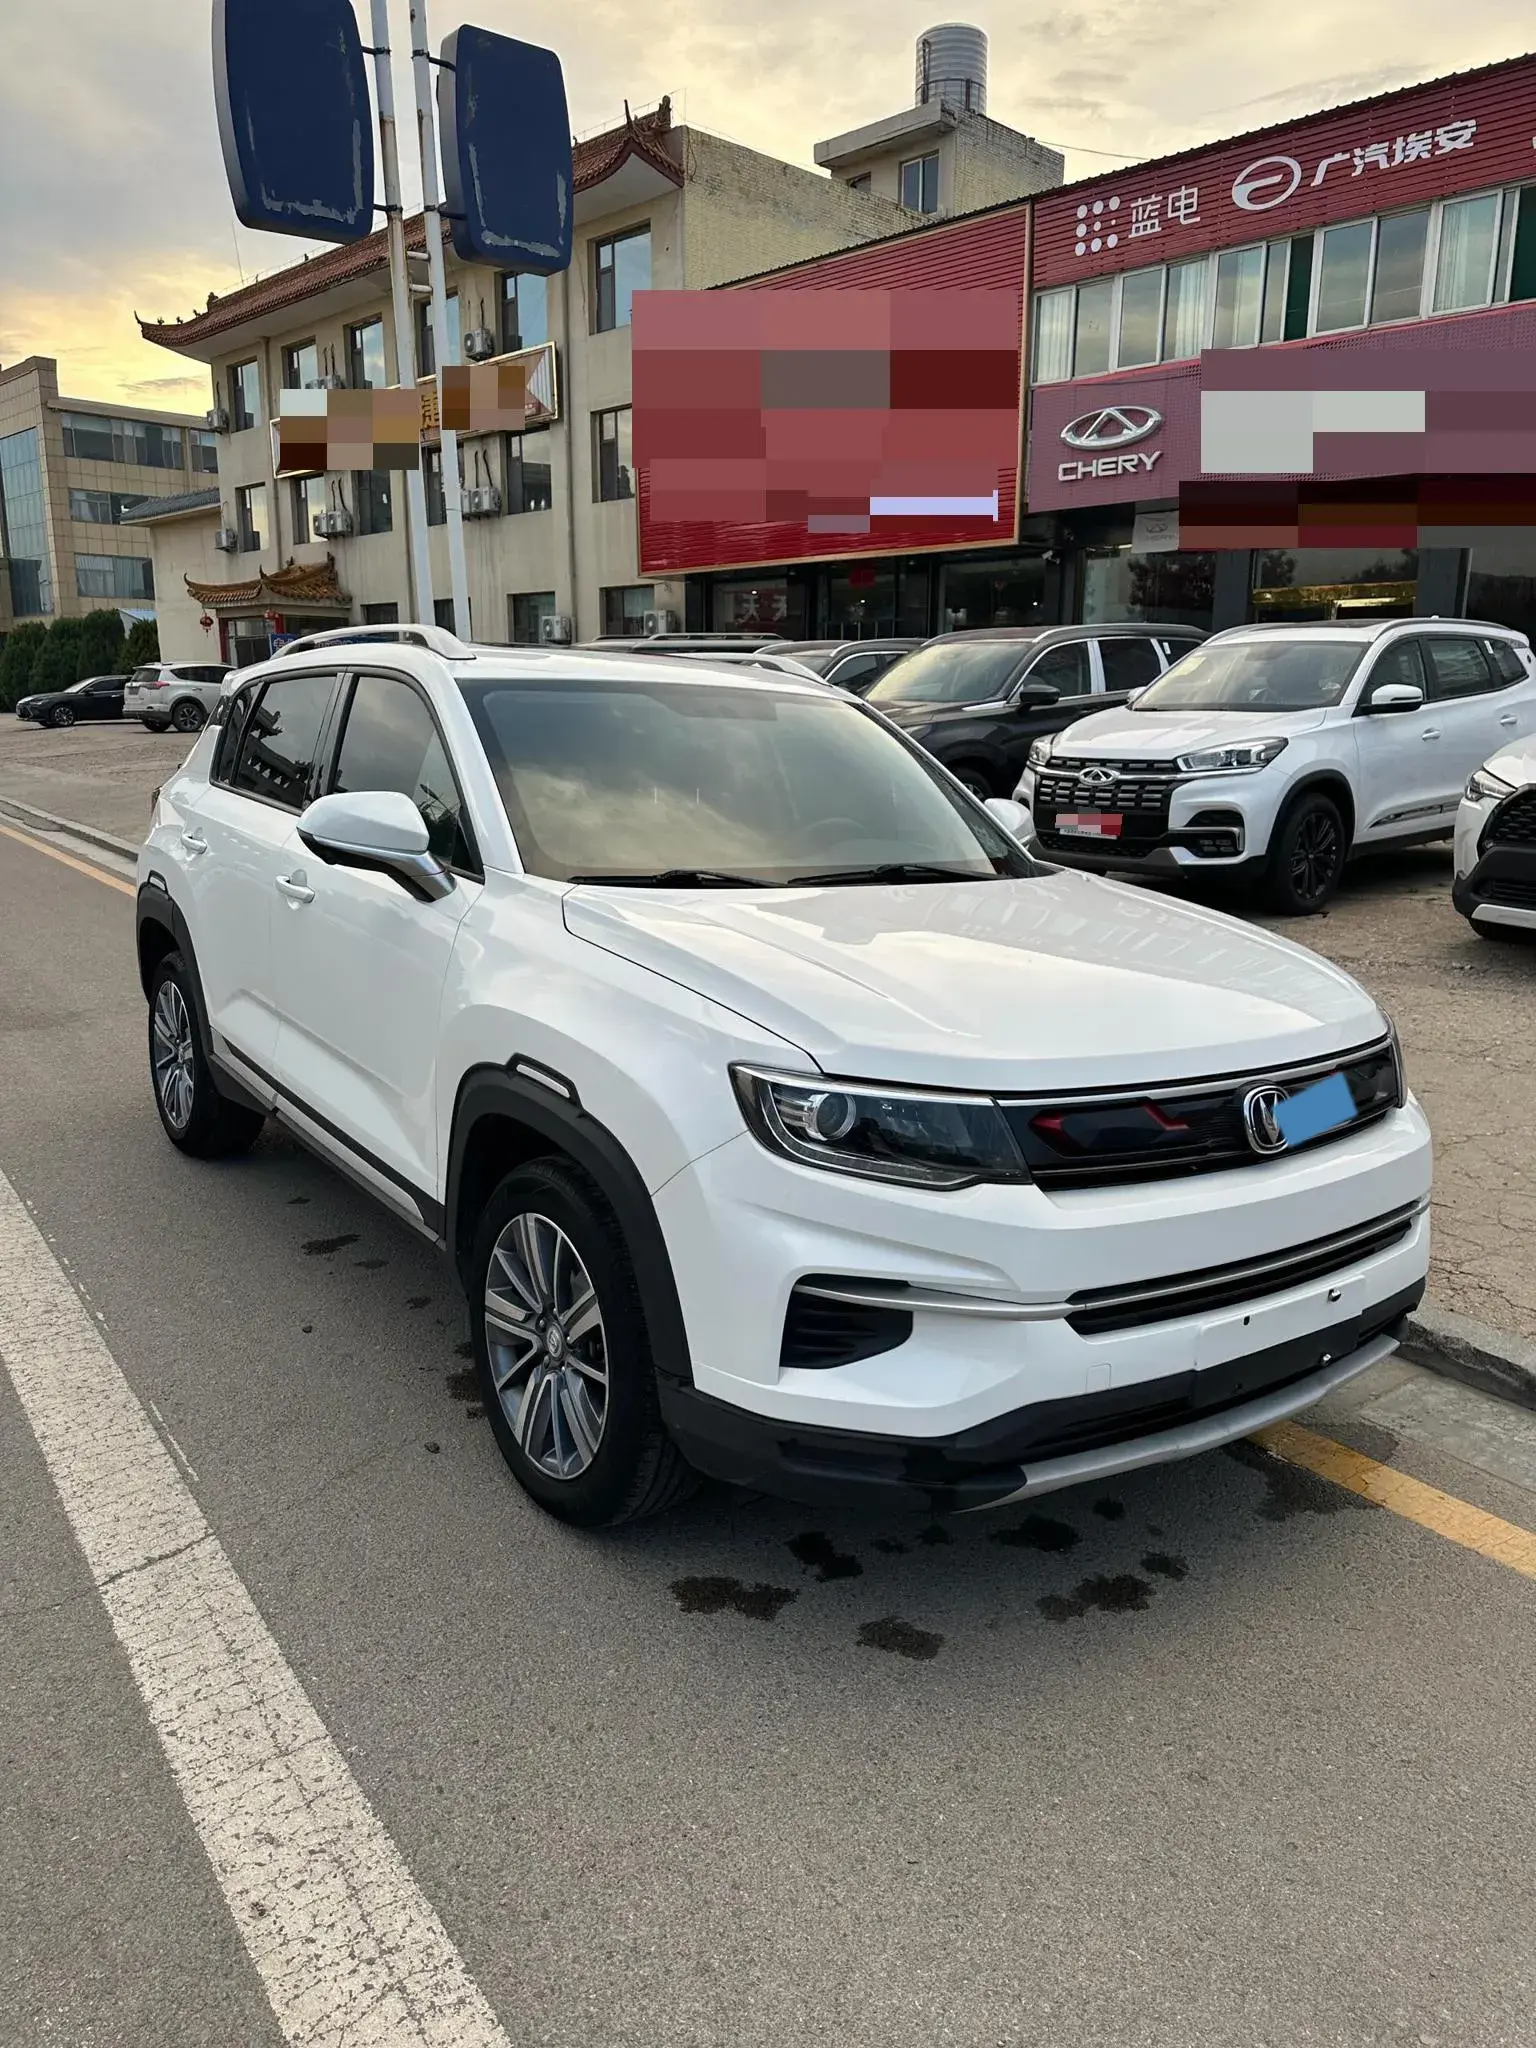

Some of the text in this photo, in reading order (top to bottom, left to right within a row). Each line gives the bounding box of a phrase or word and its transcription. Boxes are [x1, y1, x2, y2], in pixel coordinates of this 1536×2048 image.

[1310, 119, 1478, 187] 广汽埃安
[1128, 185, 1201, 239] 蓝电
[1058, 450, 1162, 481] CHERY
